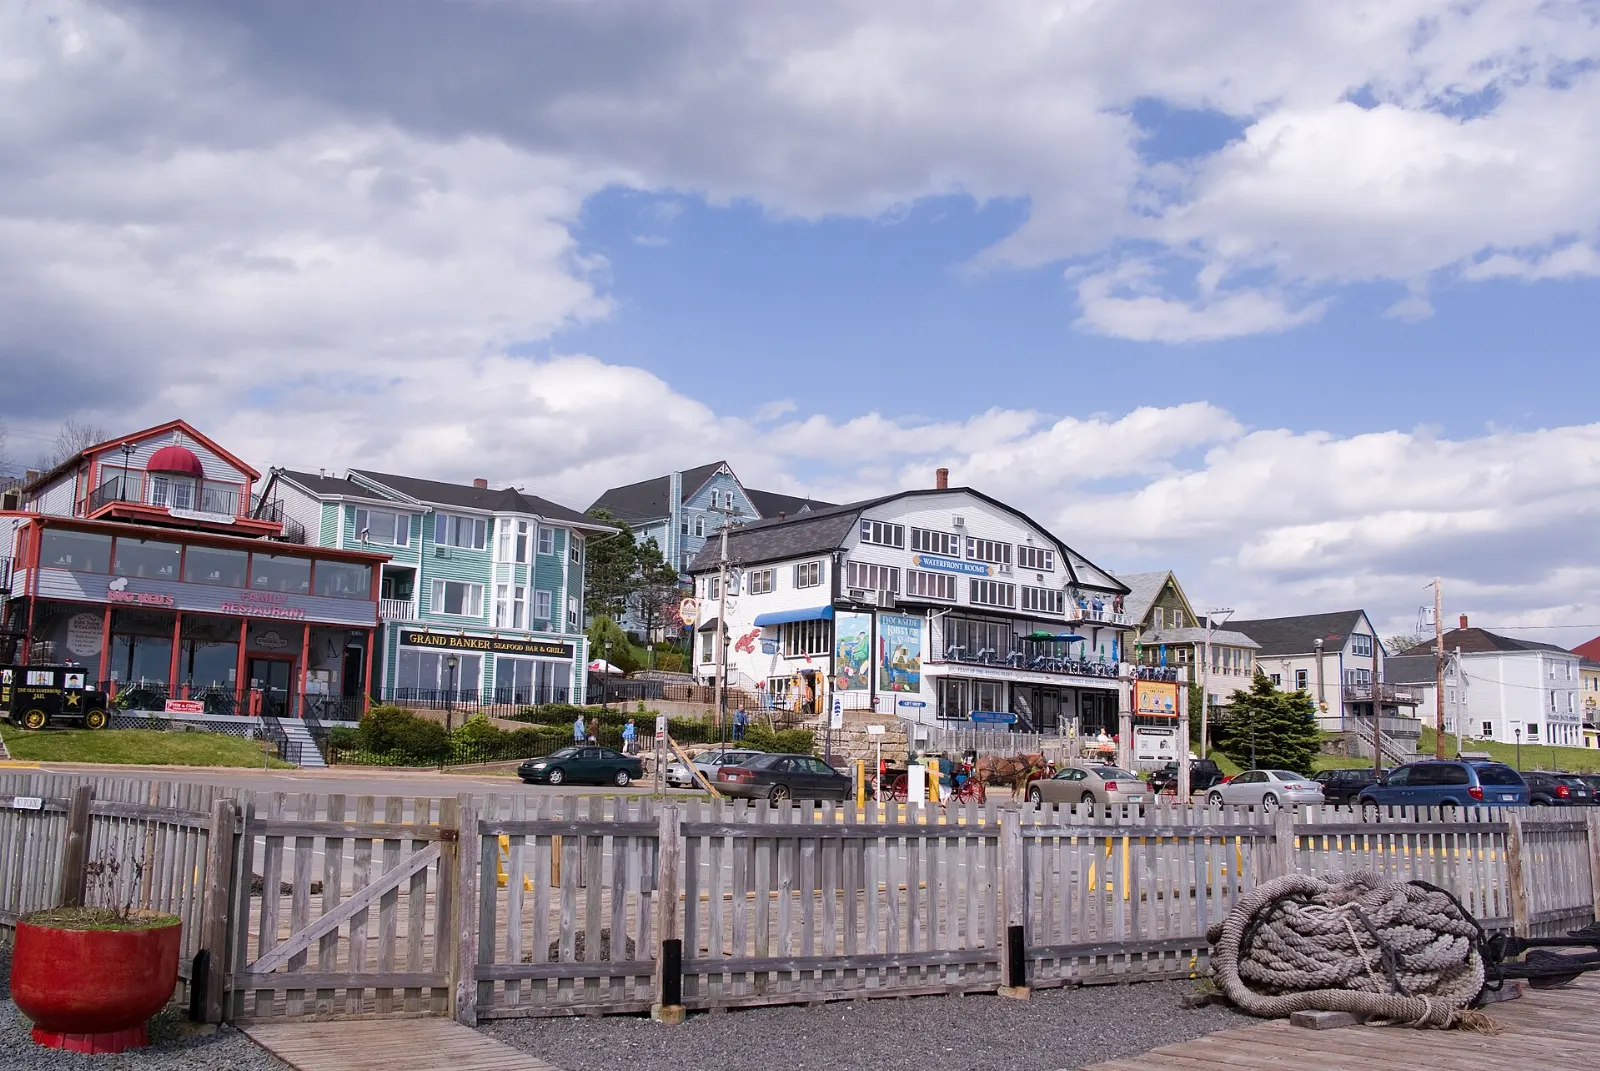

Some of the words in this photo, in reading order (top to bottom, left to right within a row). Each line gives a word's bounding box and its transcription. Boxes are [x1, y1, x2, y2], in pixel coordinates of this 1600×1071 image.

[923, 557, 963, 570] WATERFRONT
[964, 564, 985, 573] ROOMS
[107, 590, 133, 603] BIG
[241, 592, 288, 604] FAMILY
[220, 601, 306, 618] RESTAURANT
[882, 615, 918, 627] DOCKSIDE
[887, 624, 919, 636] LOBSTER
[409, 634, 447, 646] GRAND
[450, 637, 491, 650] BANKER
[493, 642, 524, 651] SEAFOOD
[546, 646, 566, 655] GRILL
